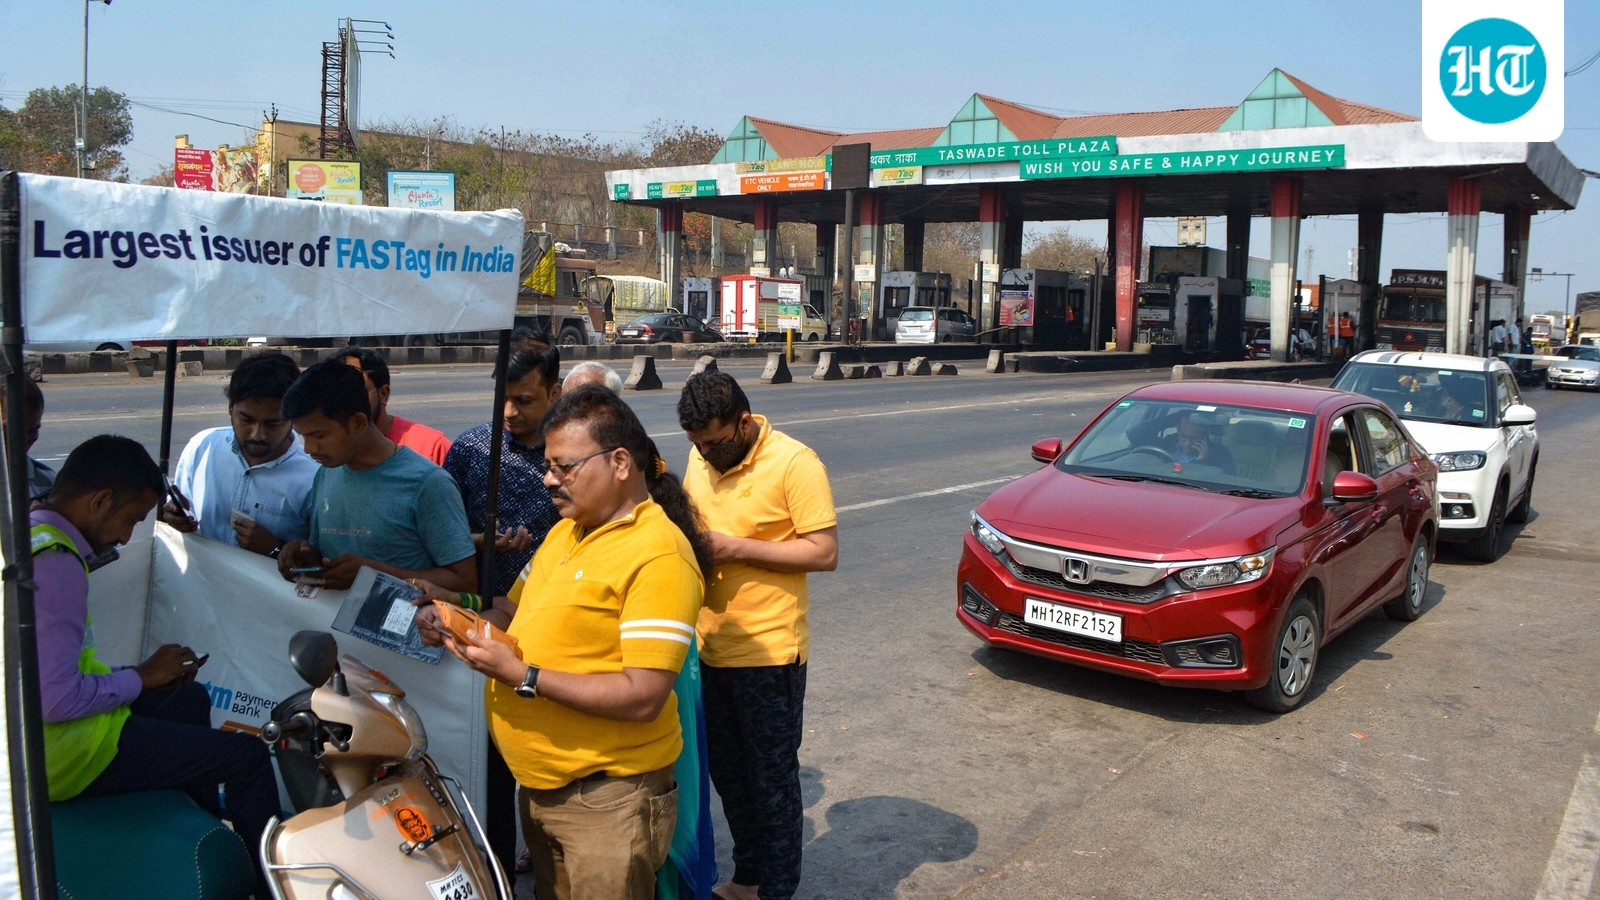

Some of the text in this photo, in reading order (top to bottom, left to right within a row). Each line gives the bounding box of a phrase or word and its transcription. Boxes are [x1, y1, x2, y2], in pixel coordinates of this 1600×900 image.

[870, 152, 917, 165] थकर नाका
[939, 140, 1111, 161] TASWADE TOLL PLAZA
[771, 161, 794, 171] LANE
[1025, 149, 1336, 175] WISH YOU SAFE & HAPPY JOURNEY
[757, 176, 780, 184] VEHICLE
[407, 189, 435, 203] Ajanta
[418, 196, 444, 208] Resort
[33, 219, 515, 279] Largest issuer of FASTag in India
[1031, 604, 1116, 636] MH12RF2152
[234, 690, 279, 710] Paymen
[231, 702, 261, 719] Bank
